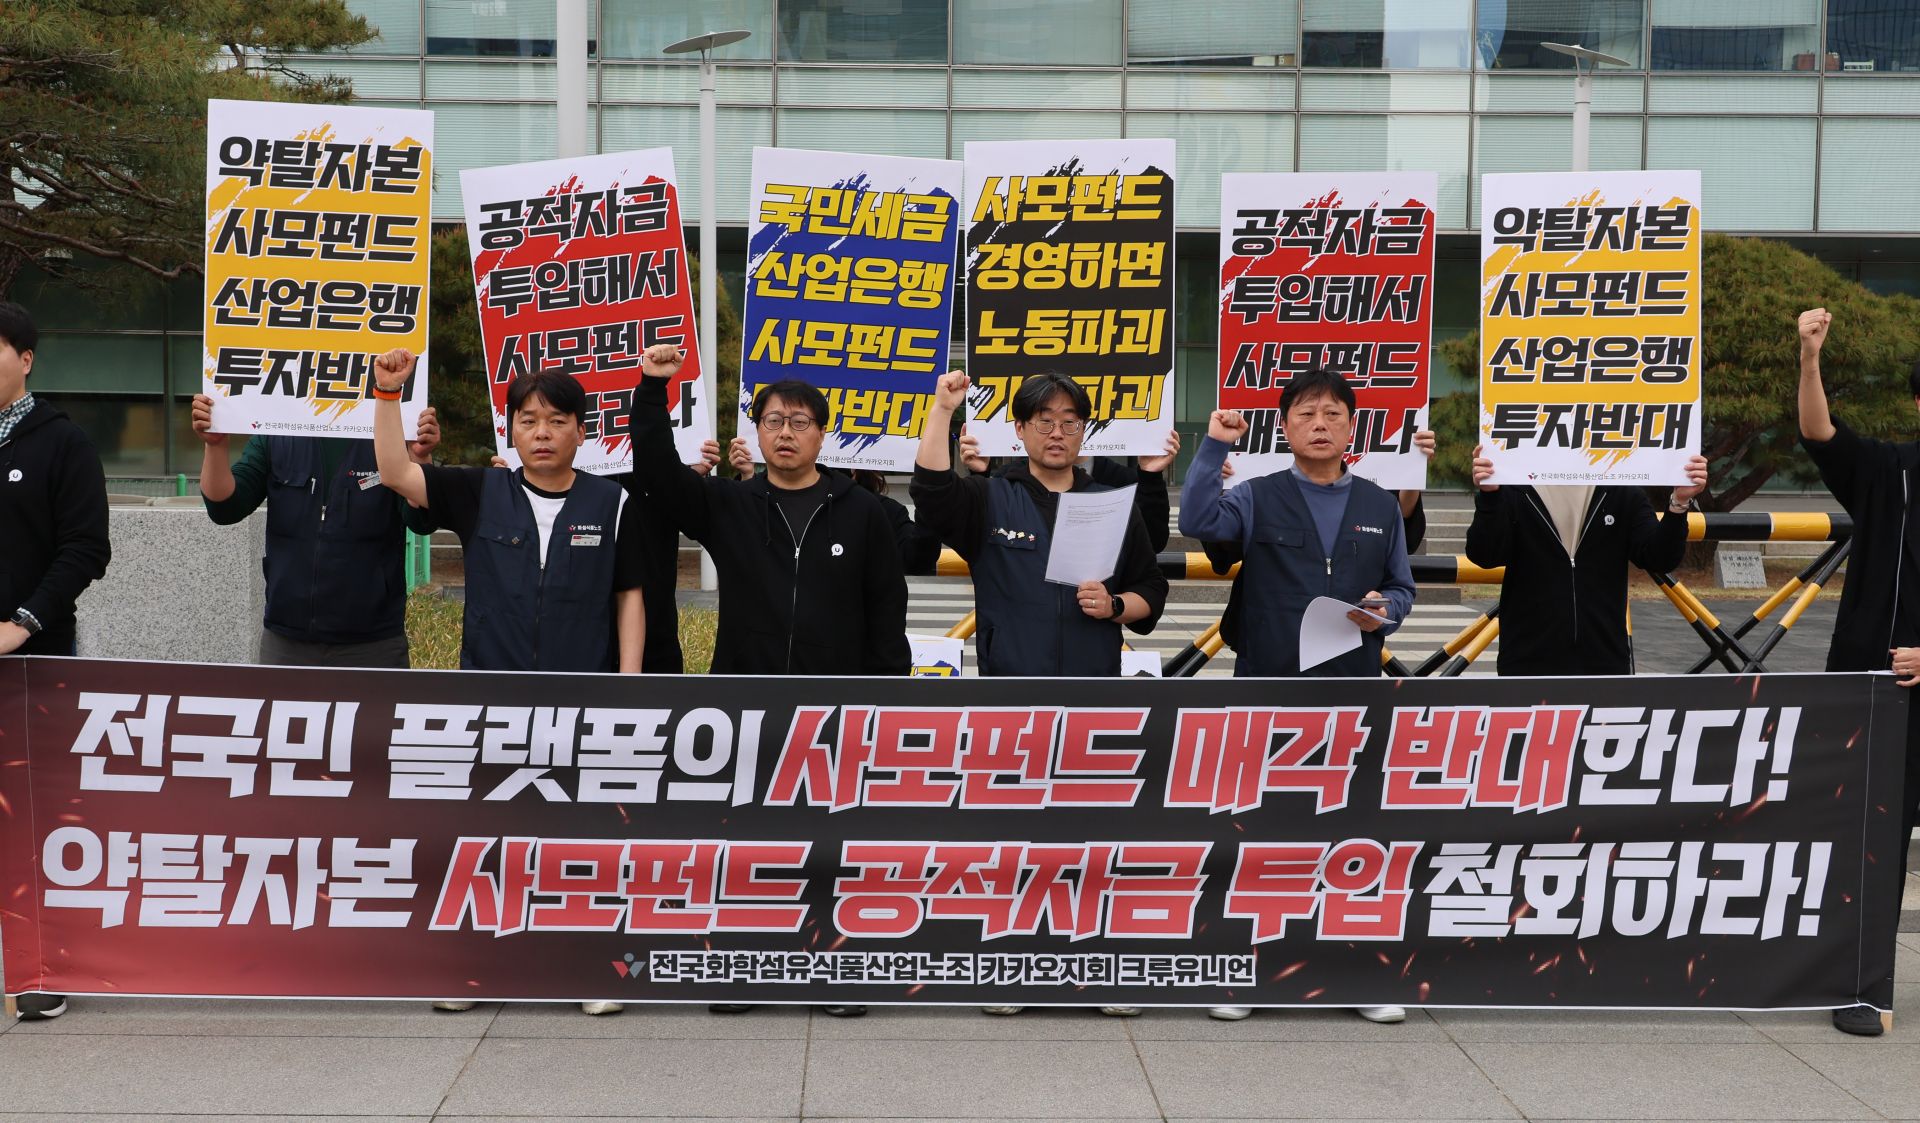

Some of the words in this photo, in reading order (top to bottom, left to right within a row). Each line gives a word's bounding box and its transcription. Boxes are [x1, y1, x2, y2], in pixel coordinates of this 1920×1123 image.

[218, 136, 424, 194] 약탈자본
[479, 182, 670, 251] 공적자금
[759, 183, 952, 243] 국민세금
[971, 175, 1164, 223] 사모펀드
[212, 207, 420, 263] 사모펀드
[1232, 207, 1427, 257] 공적자금
[1493, 205, 1691, 253] 약탈자본
[488, 247, 679, 319] 투입해서
[753, 251, 949, 309] 산업은행
[976, 242, 1166, 290] 경영하면
[212, 276, 424, 335] 산업은행
[1229, 273, 1426, 325] 투입해서
[1487, 271, 1690, 319] 사모펀드
[494, 314, 687, 384] 사모펀드
[748, 318, 940, 373] 사모펀드
[975, 308, 1166, 356] 노동파괴
[1223, 342, 1421, 390] 사모펀드
[1487, 336, 1695, 384] 산업은행
[974, 375, 1166, 422] 기파괴
[264, 421, 341, 432] 전국화학섬유식품산업노조
[1490, 403, 1694, 450] 투자반대
[865, 458, 895, 466] 카카오지회
[1540, 472, 1616, 481] 전국화학섬유식품산업노조
[1618, 472, 1650, 481] 카카오지회
[70, 692, 360, 799] 전국민
[388, 703, 766, 807] 플랫폼의
[763, 704, 1151, 814] 사모펀드
[1163, 704, 1372, 816] 매각
[1380, 704, 1802, 816] 반대한다!
[42, 826, 418, 931] 약탈자본
[427, 835, 813, 939] 사모펀드
[833, 839, 1214, 942] 공적자금
[1223, 837, 1425, 945] 투입
[1423, 841, 1832, 941] 철회하라!
[649, 950, 974, 985] 전국화학섬유식품산업노조
[979, 952, 1114, 987] 카카오지회
[1118, 954, 1256, 988] 크루유니언
